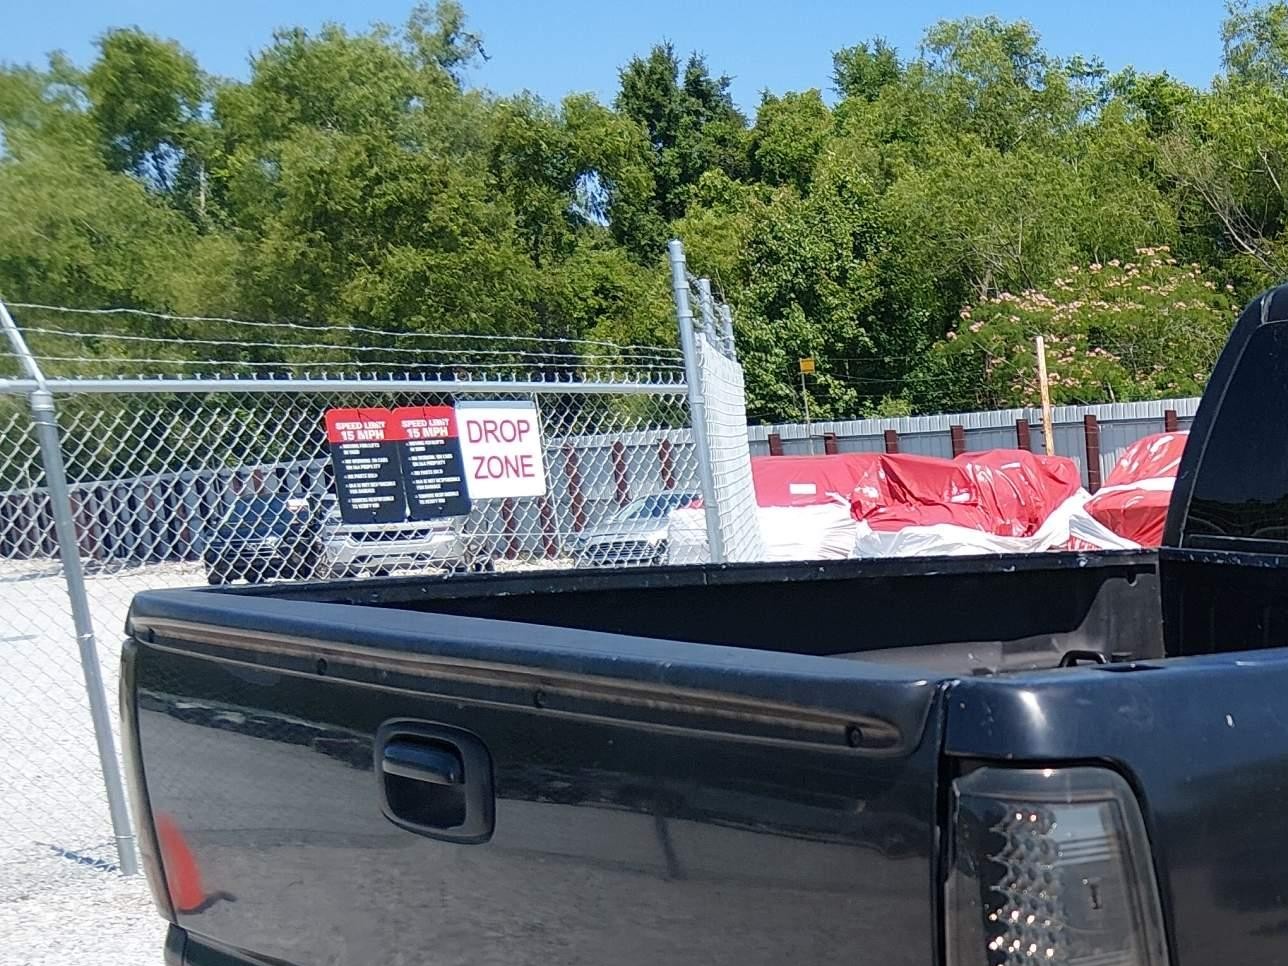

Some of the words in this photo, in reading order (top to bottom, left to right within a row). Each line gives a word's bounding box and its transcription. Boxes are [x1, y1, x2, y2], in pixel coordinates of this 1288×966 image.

[335, 421, 363, 430] SPEED
[401, 419, 428, 428] SPEED
[340, 430, 355, 441] 15
[356, 429, 385, 441] MPH
[406, 428, 421, 439] 15
[421, 426, 449, 439] MPH
[466, 419, 530, 443] DROP
[472, 454, 535, 479] ZONE
